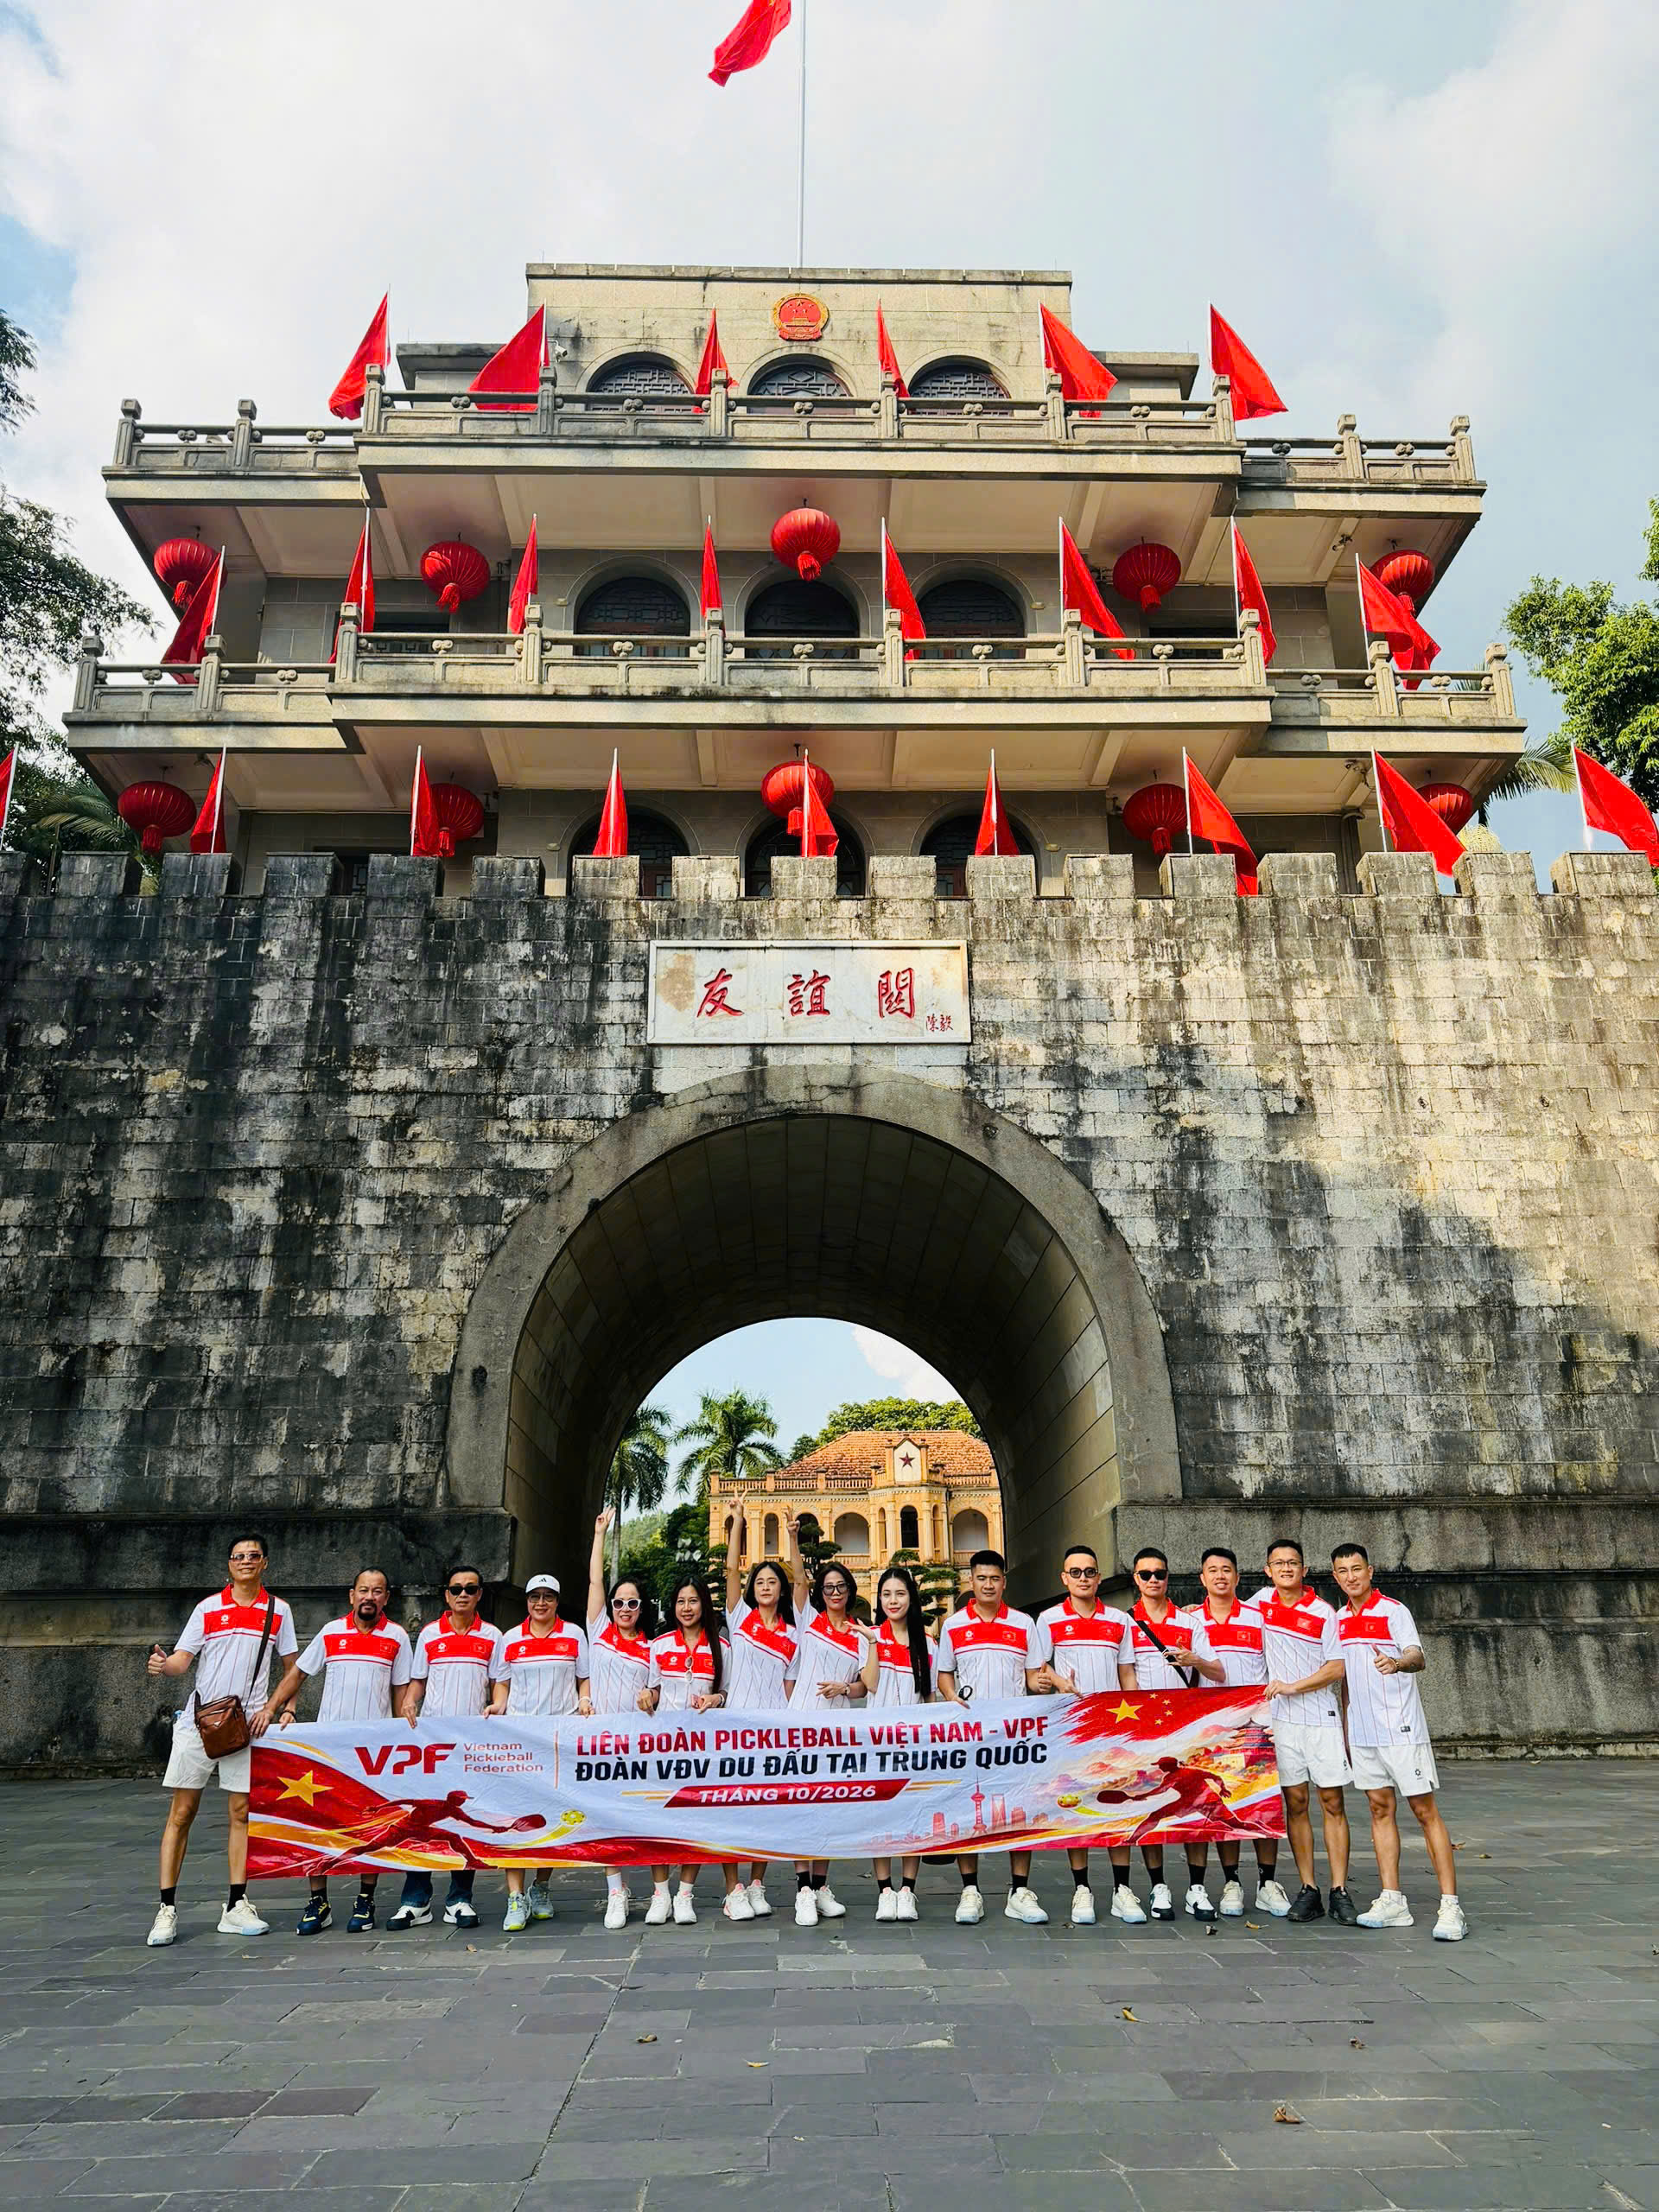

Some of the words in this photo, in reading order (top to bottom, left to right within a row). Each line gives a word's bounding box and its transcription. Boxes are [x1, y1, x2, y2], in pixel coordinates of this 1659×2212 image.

[576, 1731, 630, 1756] LIÊN
[638, 1727, 706, 1754] ĐOÀN
[715, 1726, 863, 1751] PICKLEBALL
[868, 1721, 923, 1748] VIỆT
[929, 1721, 983, 1744] NAM
[1003, 1716, 1049, 1739] VPF
[463, 1742, 523, 1751] Vietnam
[353, 1743, 457, 1776] VPF
[463, 1752, 533, 1762] Pickleball
[575, 1757, 648, 1781] ĐOÀN
[657, 1758, 711, 1780] VĐV
[719, 1757, 755, 1778] DU
[763, 1749, 819, 1777] ĐẤU
[825, 1751, 867, 1778] TẠI
[875, 1749, 967, 1772] TRUNG
[975, 1738, 1047, 1770] QUỐC
[463, 1764, 543, 1772] Federation
[699, 1785, 779, 1803] THÁNG
[786, 1785, 876, 1802] 10/2026
